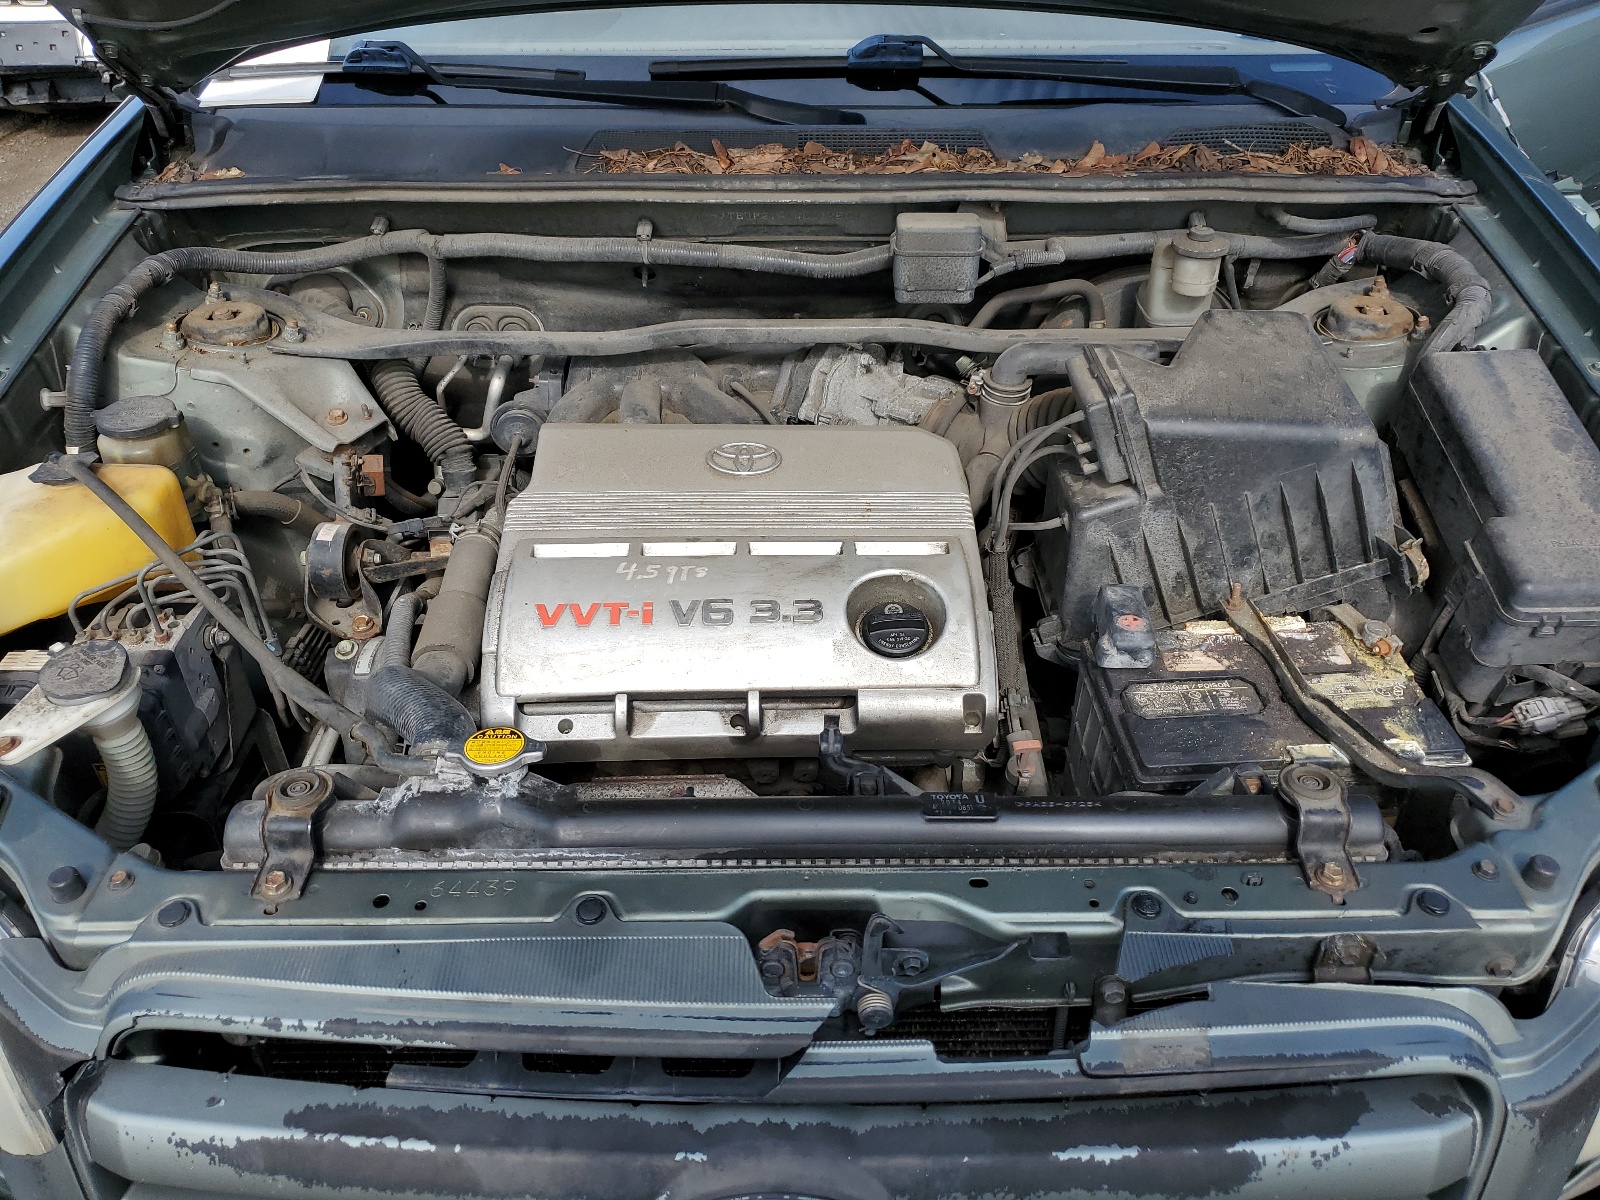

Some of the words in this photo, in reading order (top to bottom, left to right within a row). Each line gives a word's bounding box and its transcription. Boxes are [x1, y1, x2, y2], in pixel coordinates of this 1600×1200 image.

[535, 601, 654, 627] VVT-i
[670, 598, 734, 627] V6
[750, 598, 824, 624] 3.3
[1198, 680, 1231, 689] POISON
[430, 879, 517, 898] 64439
